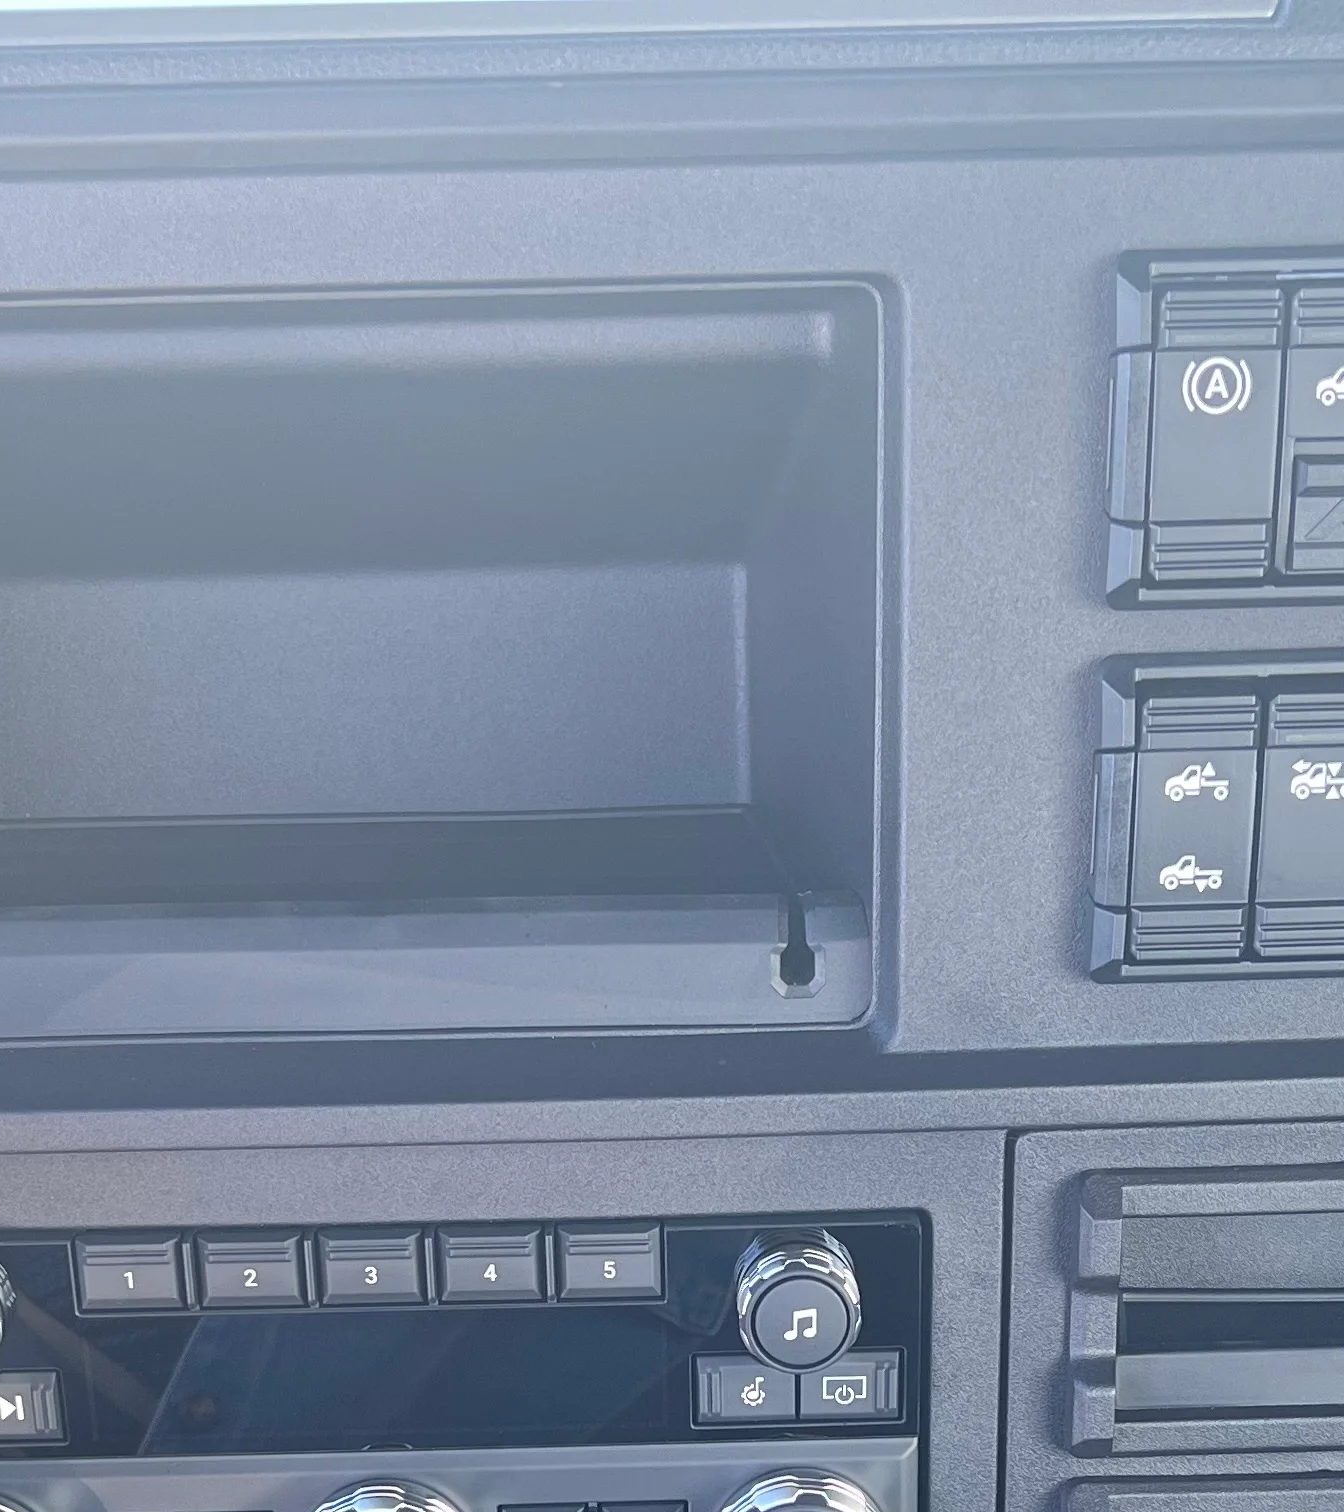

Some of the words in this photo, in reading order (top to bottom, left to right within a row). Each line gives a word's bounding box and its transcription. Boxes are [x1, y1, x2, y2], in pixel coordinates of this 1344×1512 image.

[1205, 369, 1230, 400] A
[243, 1268, 259, 1287] 2
[364, 1266, 378, 1285] 3
[483, 1263, 498, 1282] 4
[603, 1260, 617, 1279] 5
[123, 1271, 134, 1289] 1
